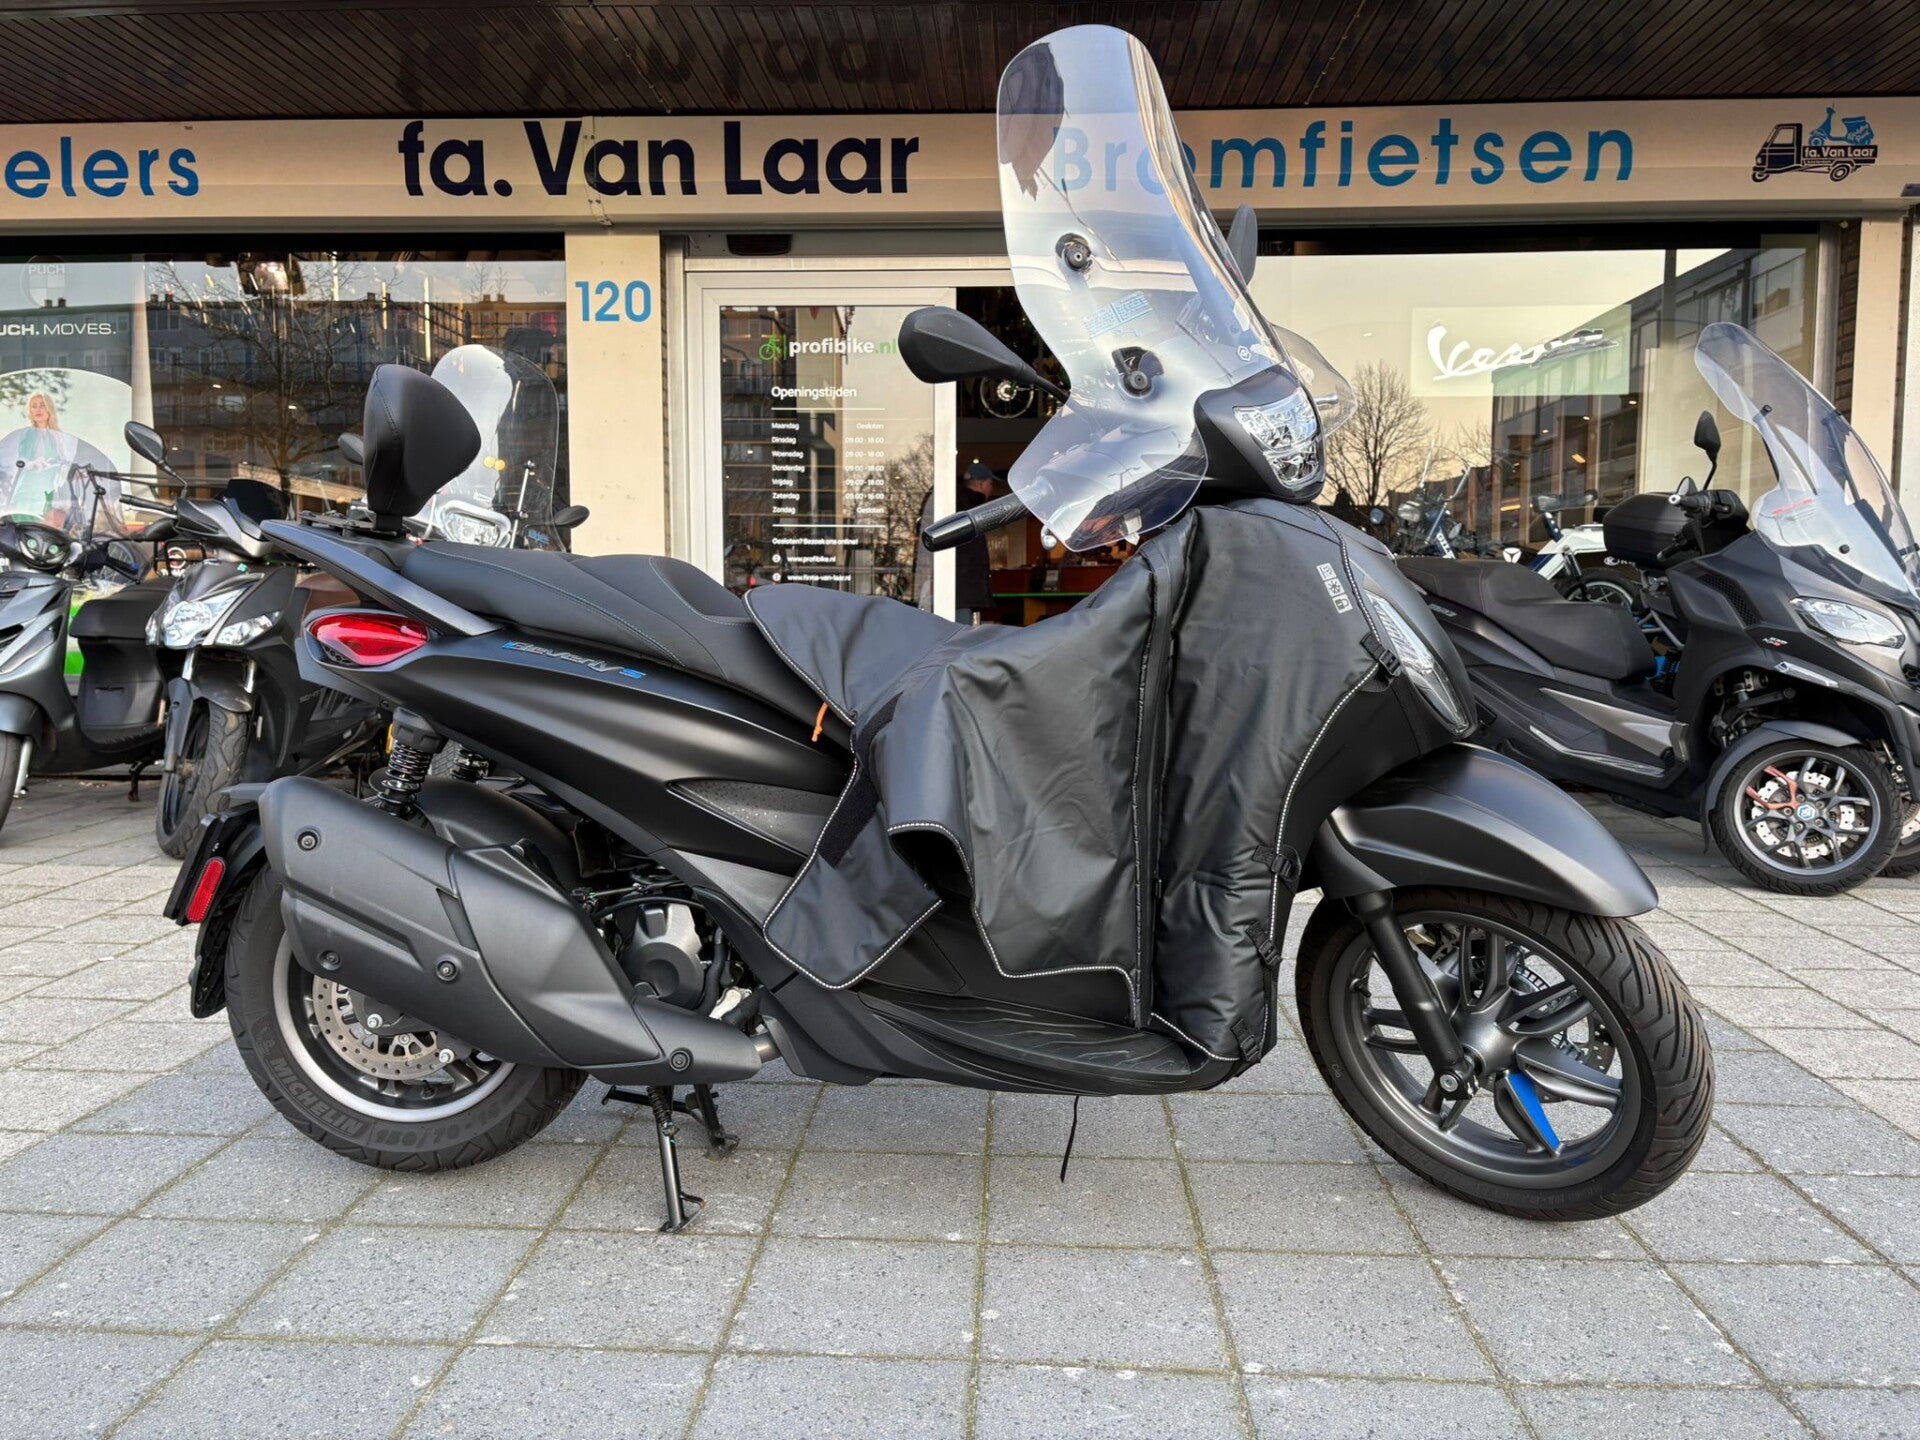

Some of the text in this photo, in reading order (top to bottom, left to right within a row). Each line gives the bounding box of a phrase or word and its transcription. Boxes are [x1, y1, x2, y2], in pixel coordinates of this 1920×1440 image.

[398, 120, 919, 196] fa. Van Laar
[1053, 118, 1633, 194] Bromfietsen
[1804, 146, 1874, 157] fa. Van Laar
[5, 137, 199, 198] elers
[28, 264, 65, 274] PUCH
[575, 280, 652, 322] 120
[43, 323, 117, 335] MOVES.
[788, 337, 897, 357] profibike.nl
[771, 386, 857, 400] Openingstijden
[270, 1057, 365, 1136] MICHELIN
